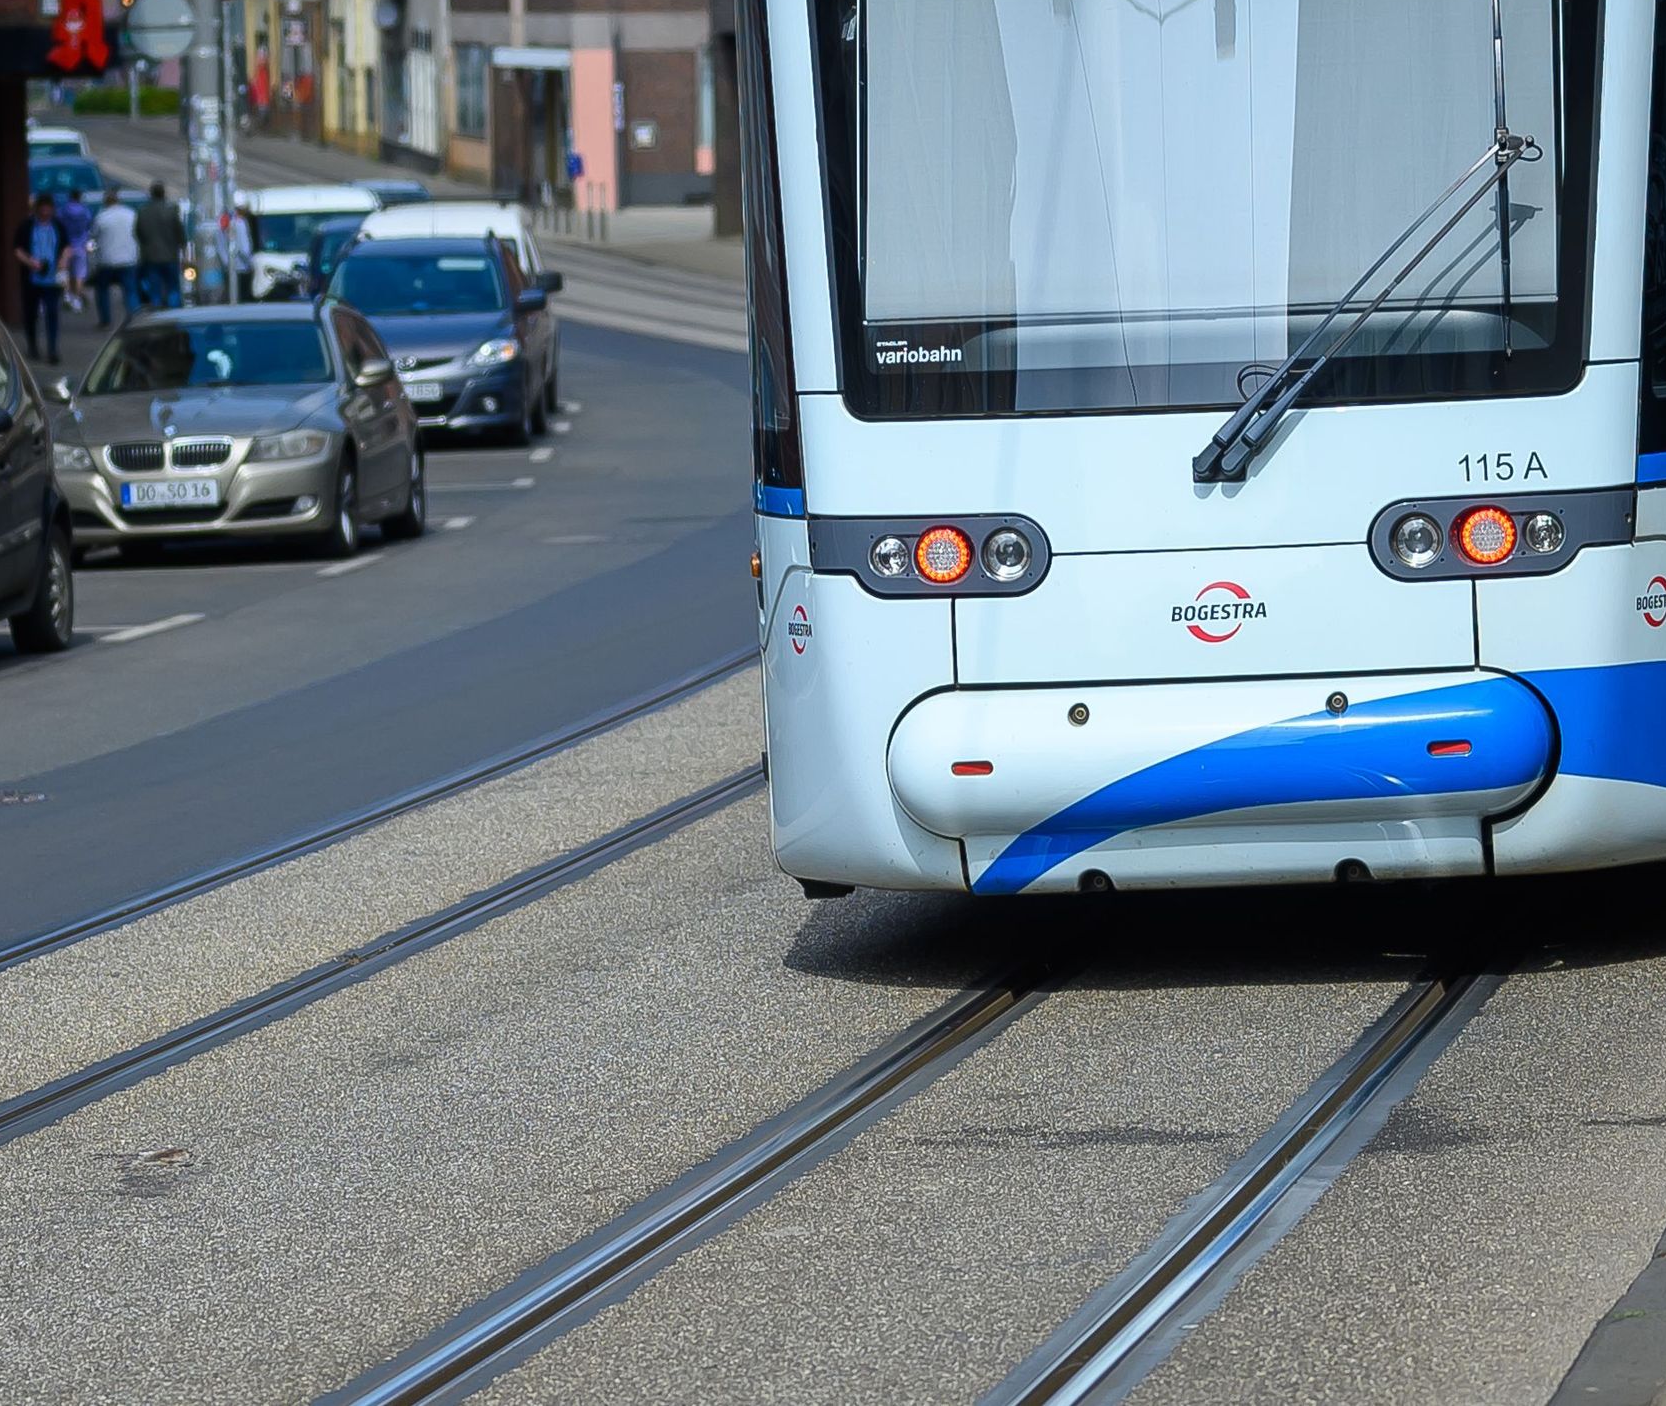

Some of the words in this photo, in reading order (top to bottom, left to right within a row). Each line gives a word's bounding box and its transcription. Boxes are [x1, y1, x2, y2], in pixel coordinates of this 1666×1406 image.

[876, 346, 962, 364] variobahn
[1458, 452, 1514, 482] 115
[1523, 451, 1548, 480] A
[137, 484, 156, 501] DO
[192, 482, 210, 498] 16
[1171, 602, 1267, 622] BOGESTRA
